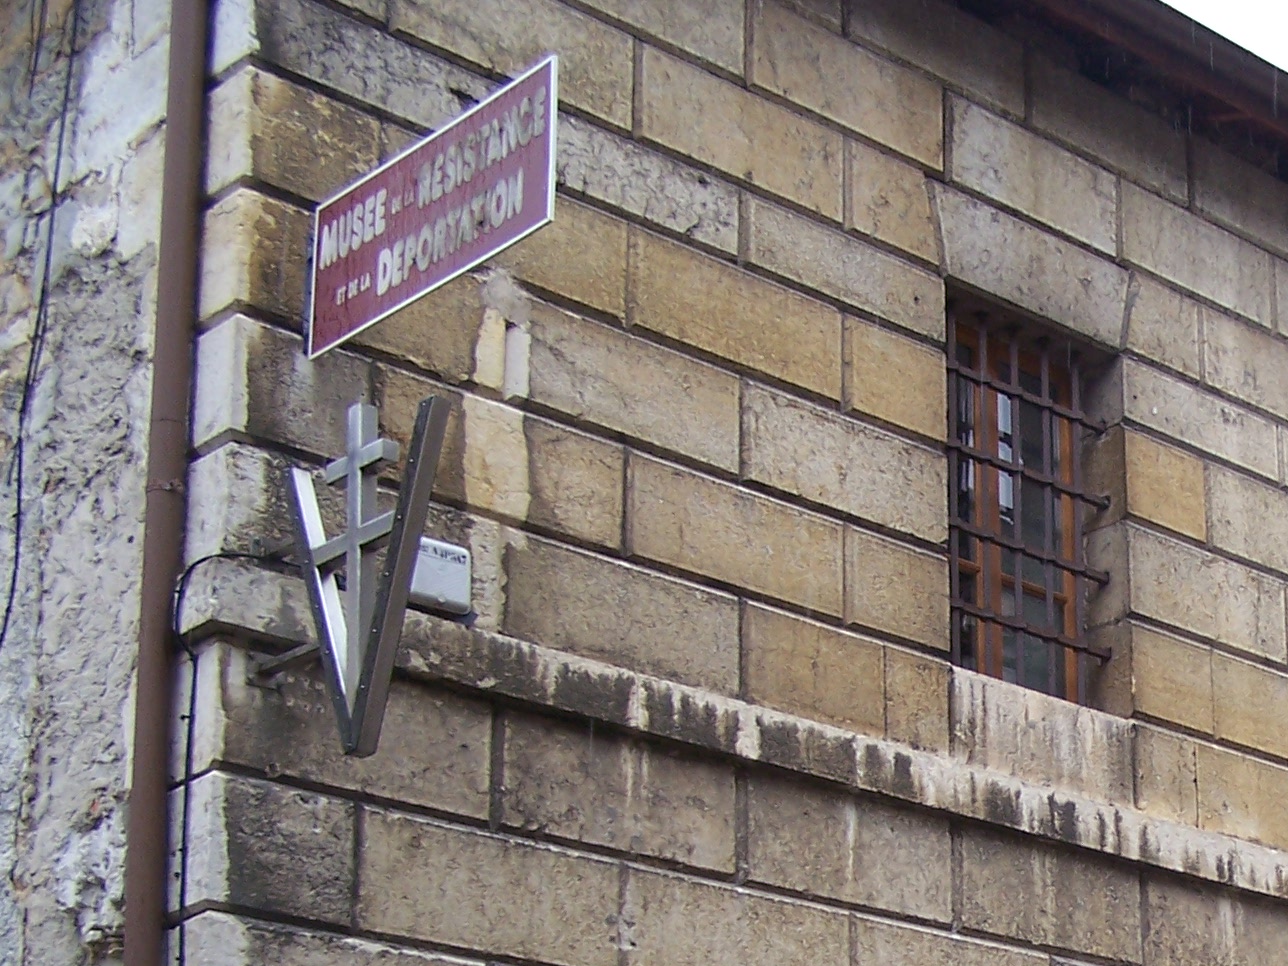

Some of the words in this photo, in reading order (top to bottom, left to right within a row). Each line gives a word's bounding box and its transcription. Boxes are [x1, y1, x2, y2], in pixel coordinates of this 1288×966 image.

[319, 188, 387, 270] MUSEE
[418, 86, 547, 209] RESISTANCE
[336, 286, 346, 306] ET
[348, 279, 359, 300] DE
[360, 272, 371, 293] LA
[377, 167, 524, 296] DEPORTATION
